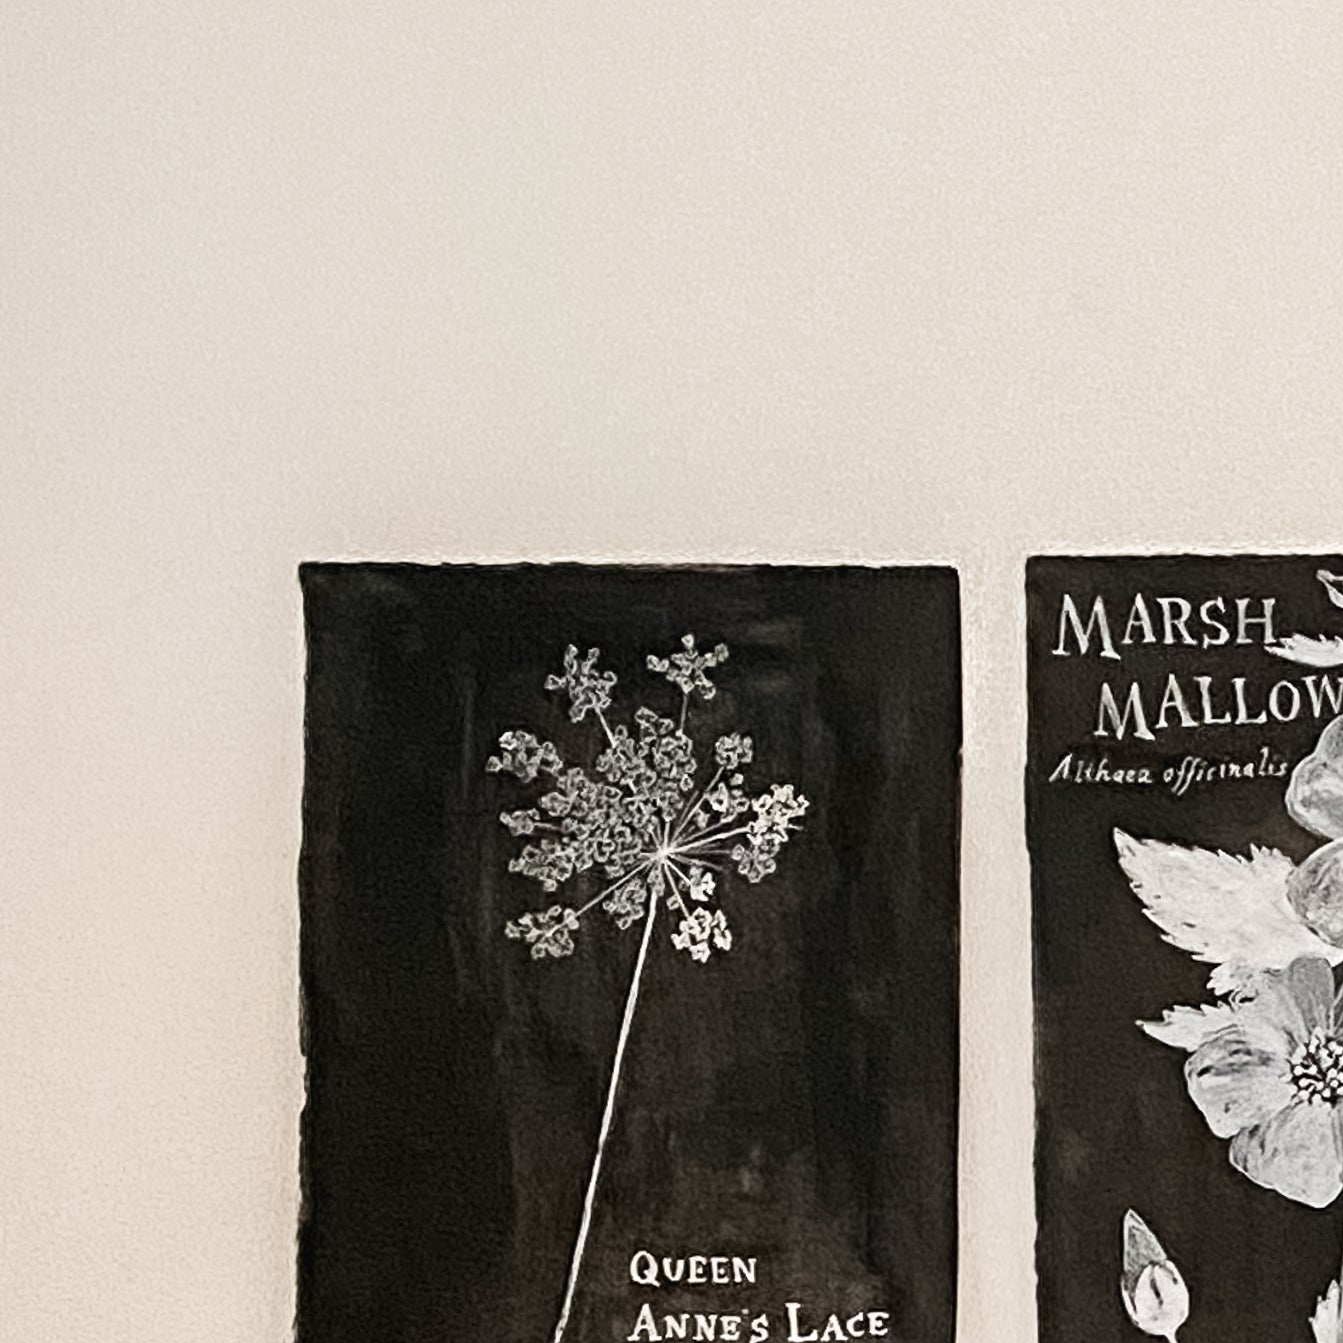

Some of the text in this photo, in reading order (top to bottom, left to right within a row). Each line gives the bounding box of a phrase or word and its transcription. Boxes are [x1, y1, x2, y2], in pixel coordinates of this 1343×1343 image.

[1052, 592, 1277, 661] MARSH
[1163, 746, 1287, 796] officinalis
[629, 1250, 757, 1287] QUEEN
[785, 1302, 890, 1343] LACE
